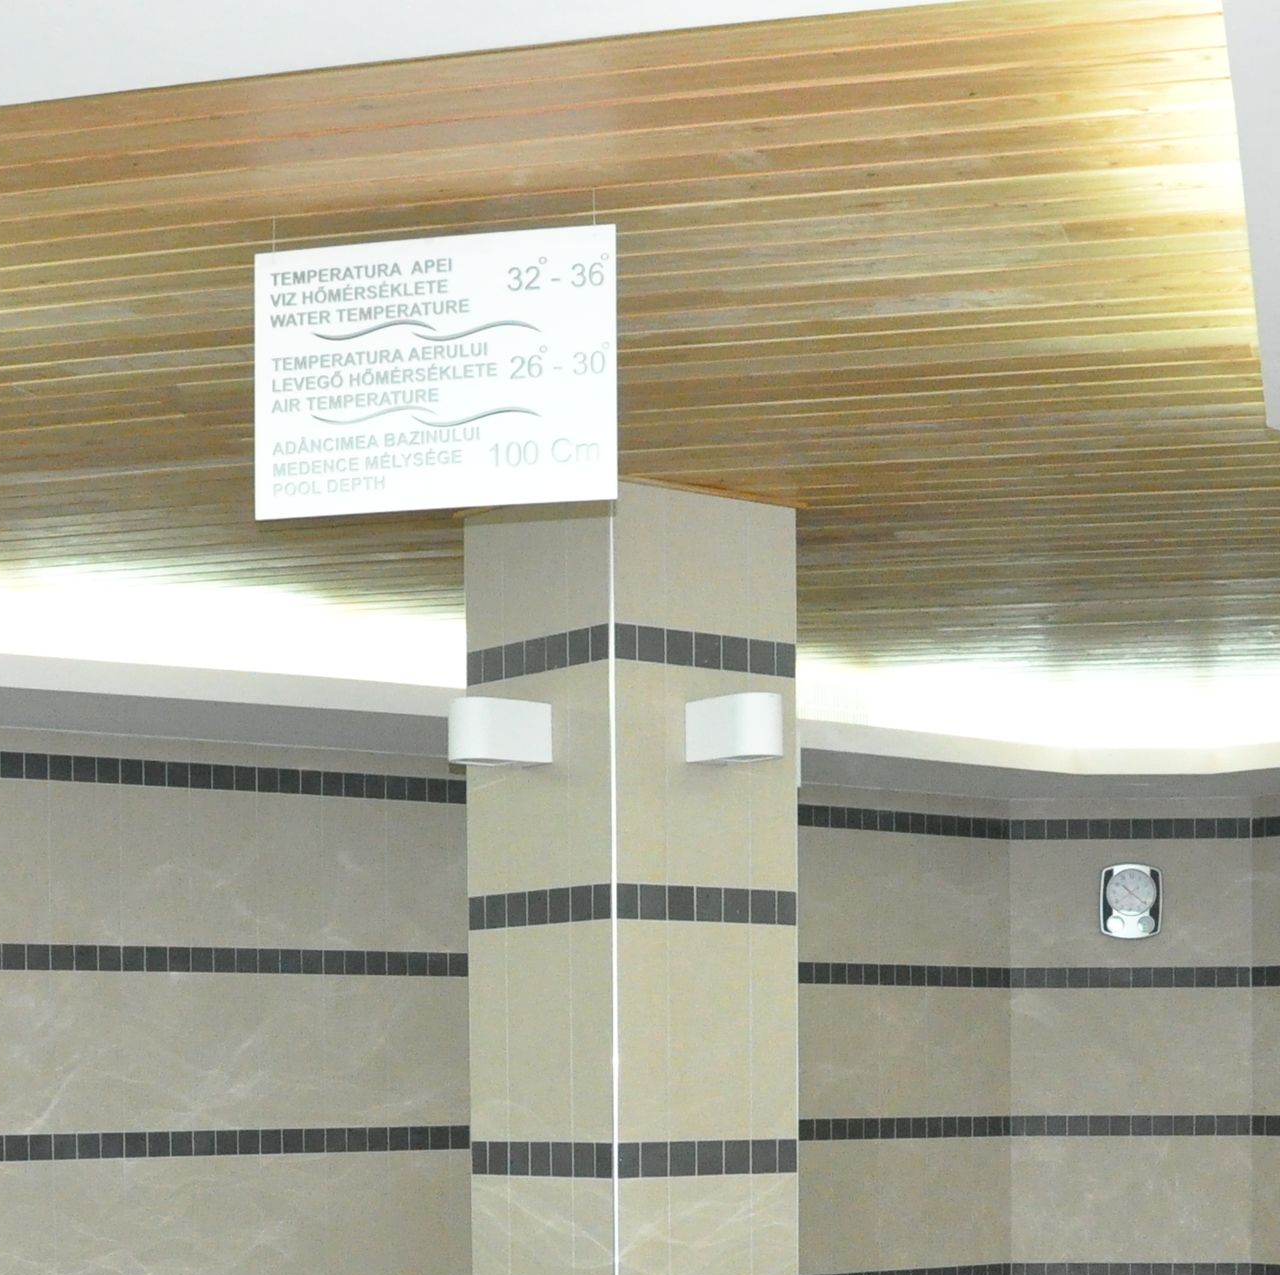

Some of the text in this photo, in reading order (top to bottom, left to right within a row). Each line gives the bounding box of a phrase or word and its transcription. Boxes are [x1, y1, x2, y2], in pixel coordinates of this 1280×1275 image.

[271, 258, 452, 287] TEMPERATURA APEI
[270, 279, 448, 307] VIZ HŐMÉRSÉKLETE
[270, 299, 470, 328] WATER TEMPERATURE
[272, 342, 488, 372] TEMPERATURA AERULUI
[272, 362, 497, 392] LEVEGŐ HŐMÉRSÉKLETE
[272, 388, 439, 413] AIR TEMPERATURE
[384, 427, 480, 447] BAZINULUI
[273, 448, 462, 477] MEDENCE MÉLYSÉGE
[489, 438, 601, 468] 100 Cm
[273, 475, 386, 497] POOL DEPTH
